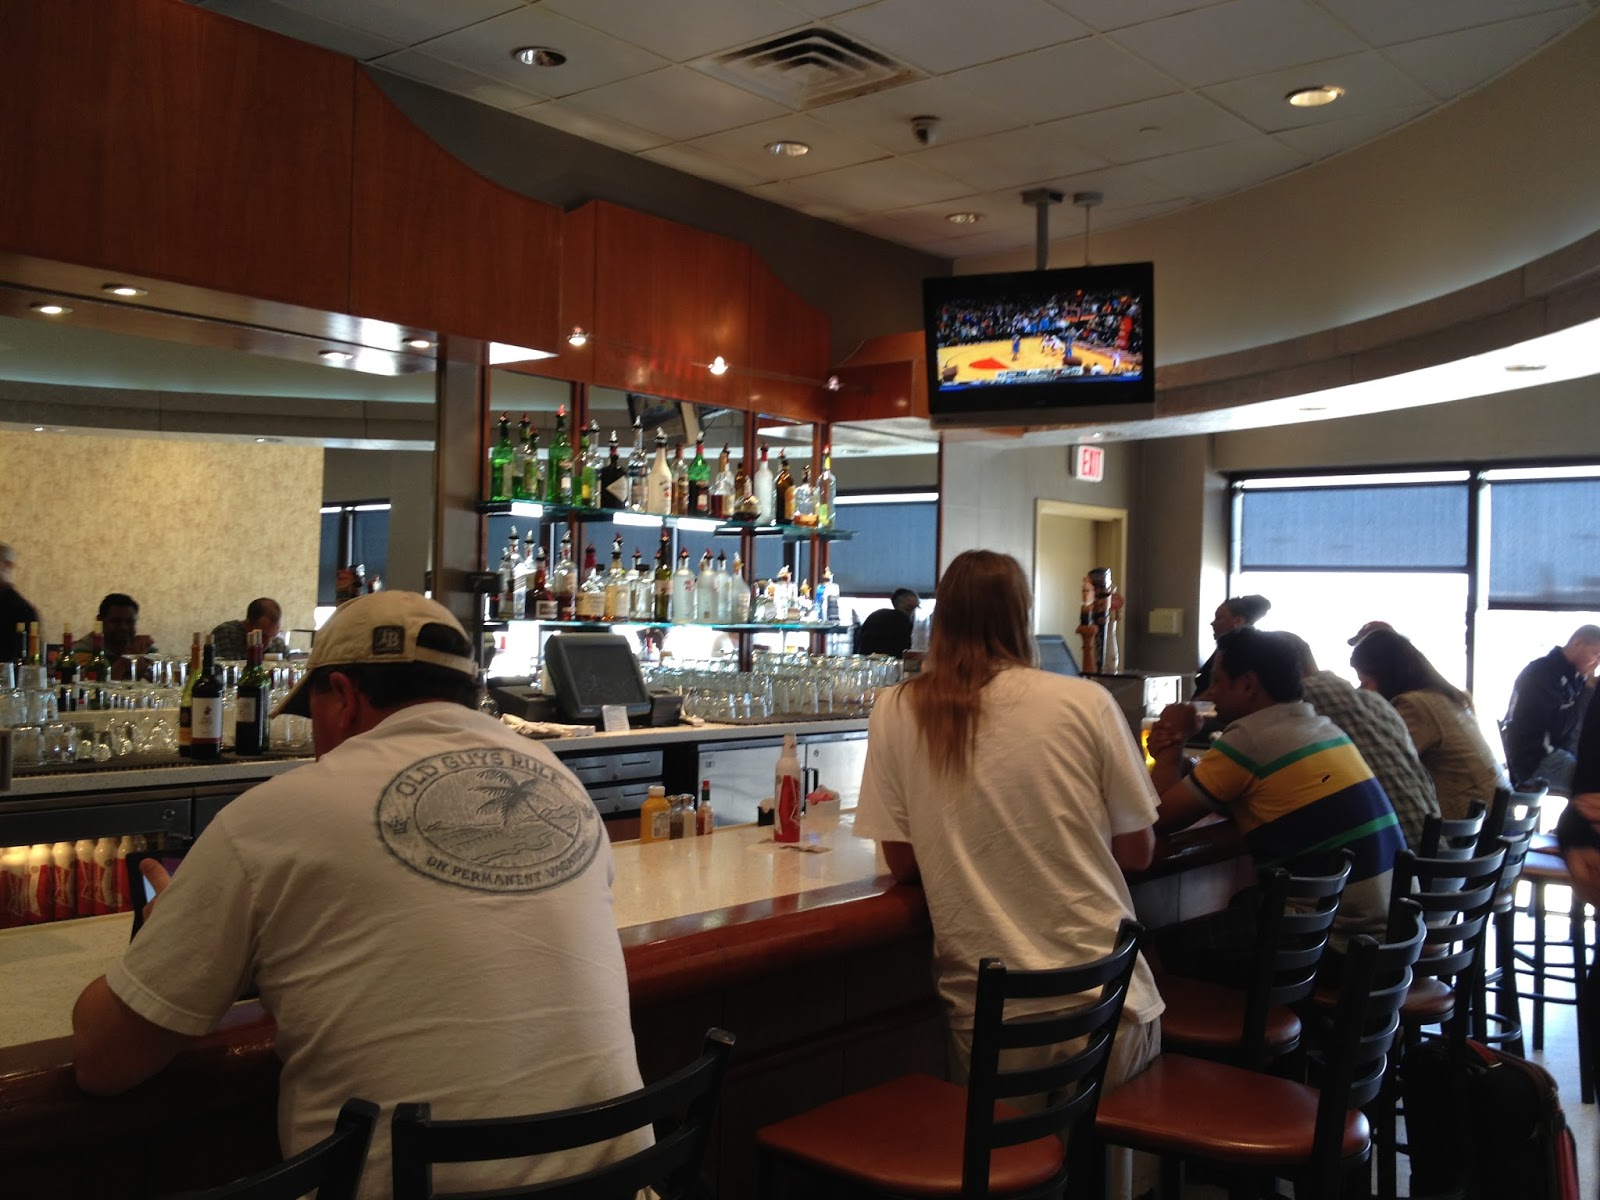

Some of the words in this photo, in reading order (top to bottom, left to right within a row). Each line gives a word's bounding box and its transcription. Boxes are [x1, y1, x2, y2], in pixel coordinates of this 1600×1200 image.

[1081, 448, 1101, 478] EXIT
[396, 762, 438, 797] OLD
[443, 751, 503, 769] GUYS
[511, 754, 564, 788] RULE
[426, 856, 449, 874] ON
[452, 865, 542, 887] PERMANENT
